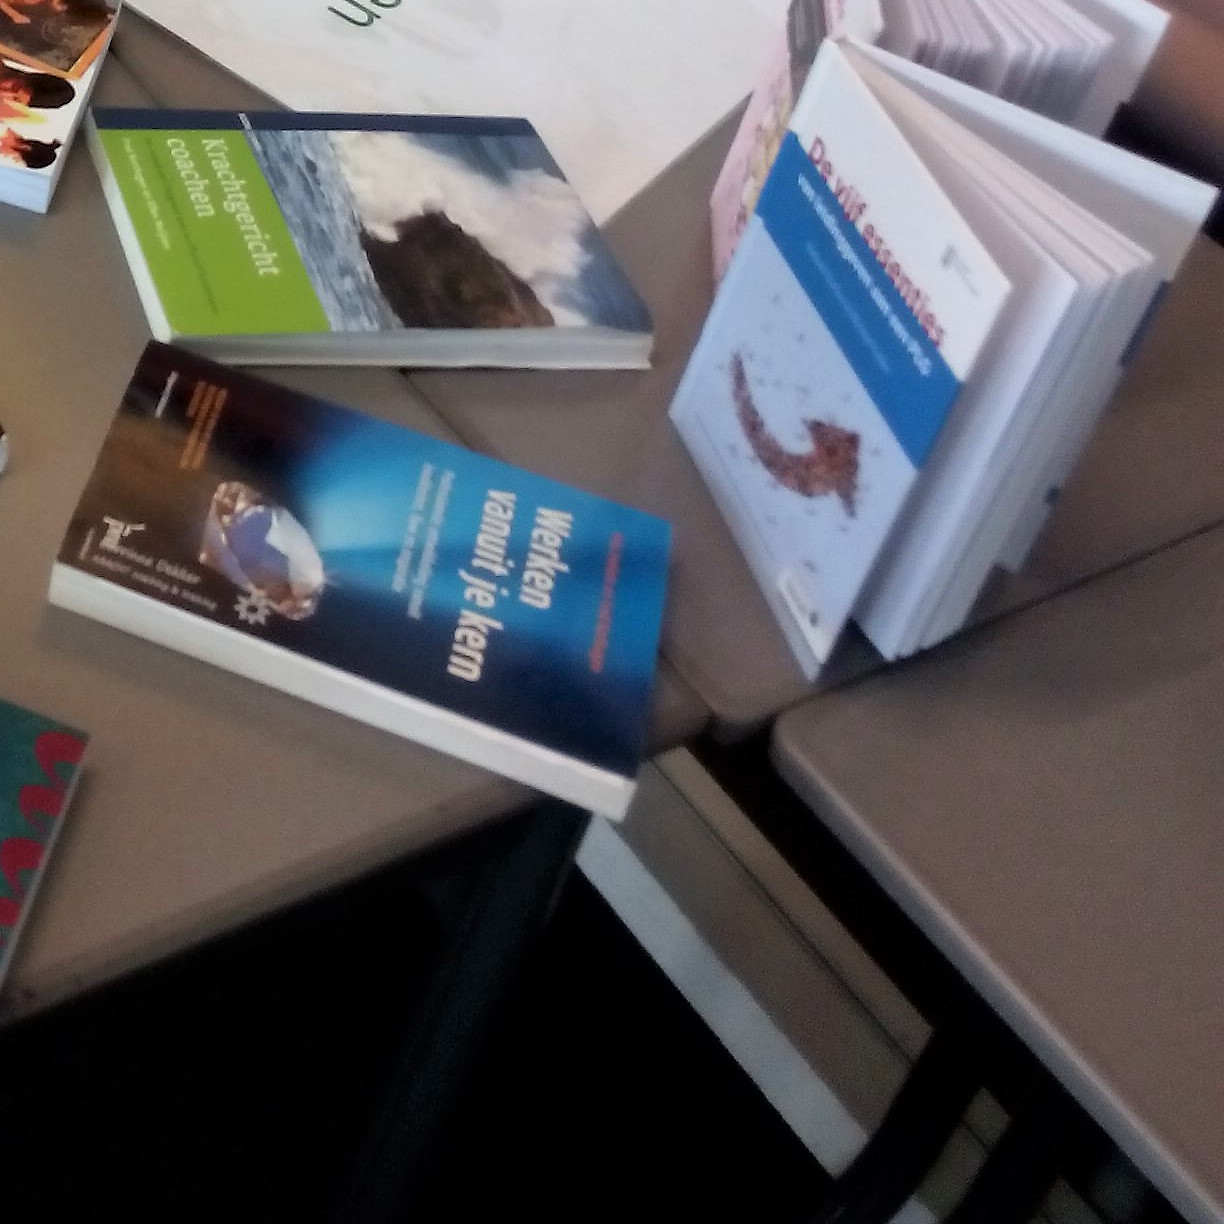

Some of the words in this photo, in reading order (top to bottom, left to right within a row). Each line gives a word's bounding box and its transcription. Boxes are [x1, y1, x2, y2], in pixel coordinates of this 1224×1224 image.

[166, 138, 215, 217] coachen
[201, 137, 280, 276] Krachtgericht
[809, 136, 832, 180] De
[833, 178, 866, 224] vijf
[862, 223, 945, 347] essenties
[472, 488, 517, 577] vanuit
[519, 507, 574, 609] Werken
[458, 568, 509, 609] je
[446, 609, 505, 683] kern
